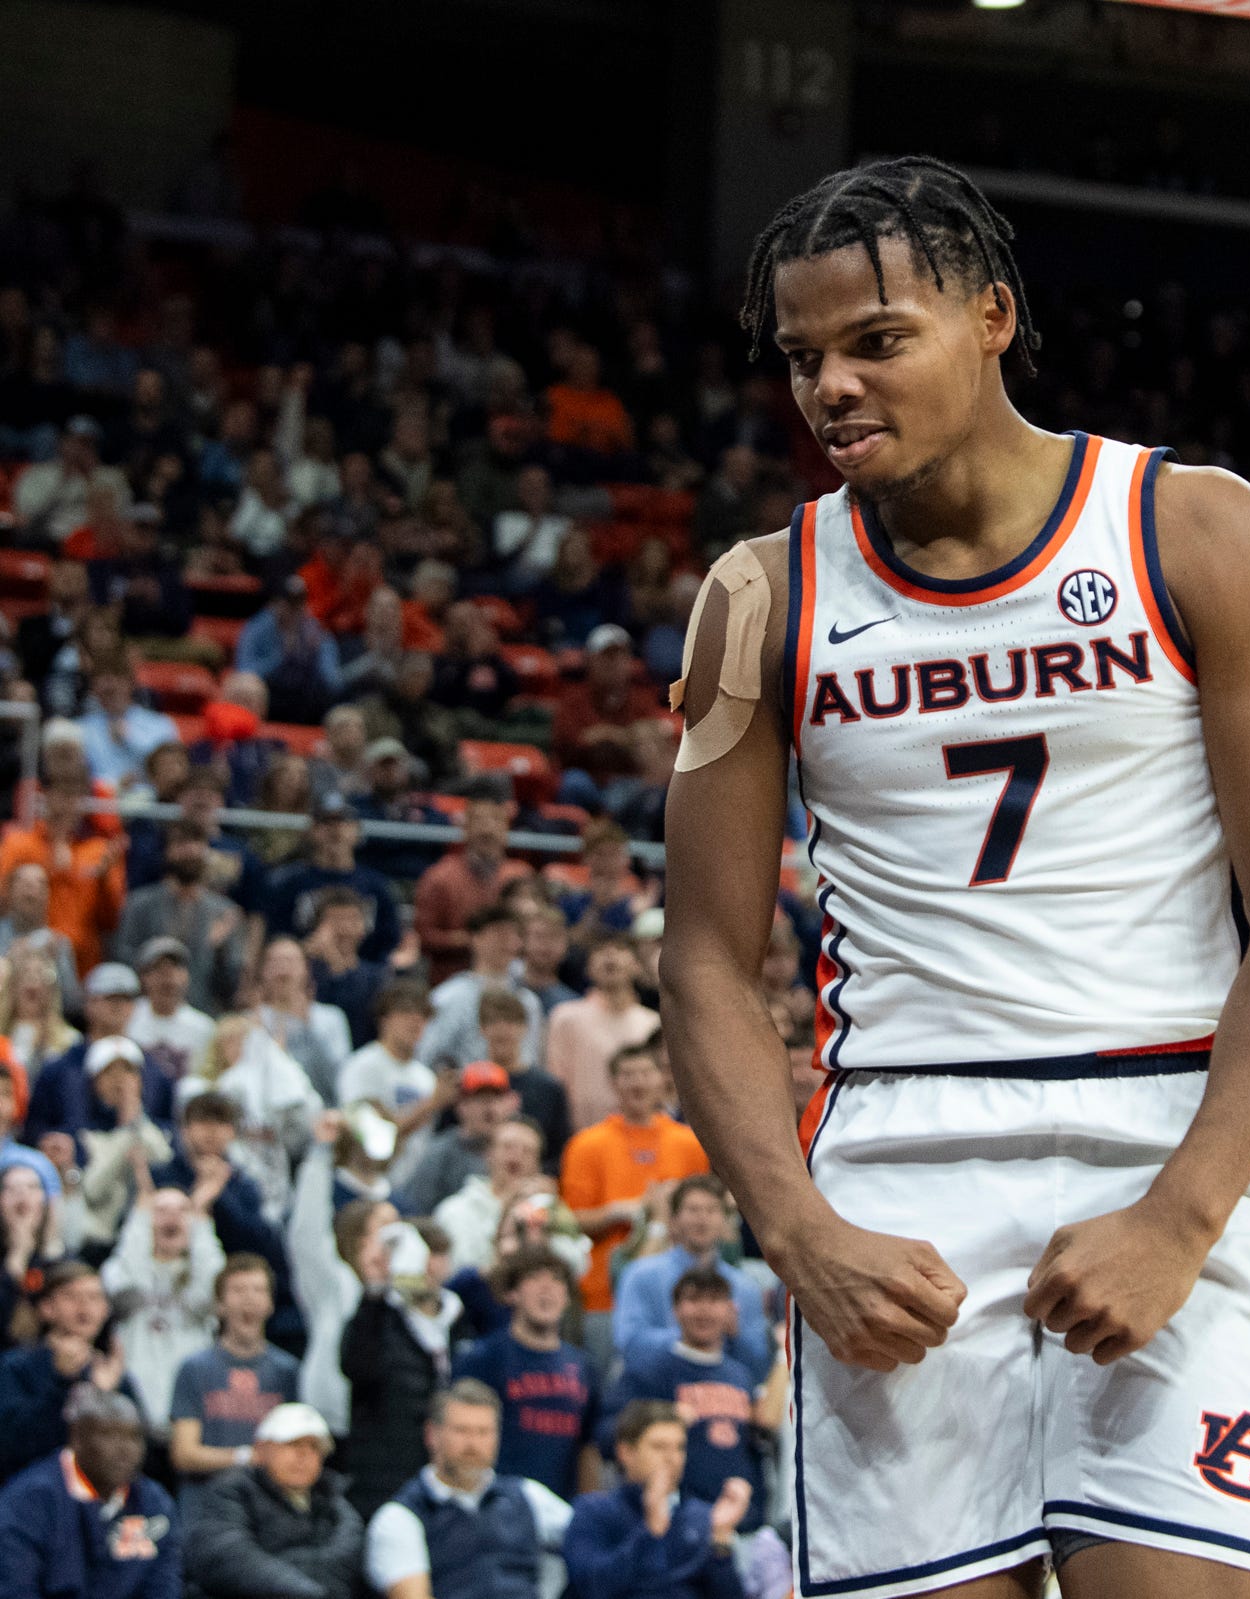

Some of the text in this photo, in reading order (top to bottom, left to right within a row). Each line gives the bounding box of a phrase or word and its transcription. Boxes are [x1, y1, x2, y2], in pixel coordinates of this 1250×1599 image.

[744, 39, 834, 103] 112
[1061, 571, 1116, 624] SEC
[810, 631, 1153, 726] AUBURN
[942, 732, 1051, 887] 7
